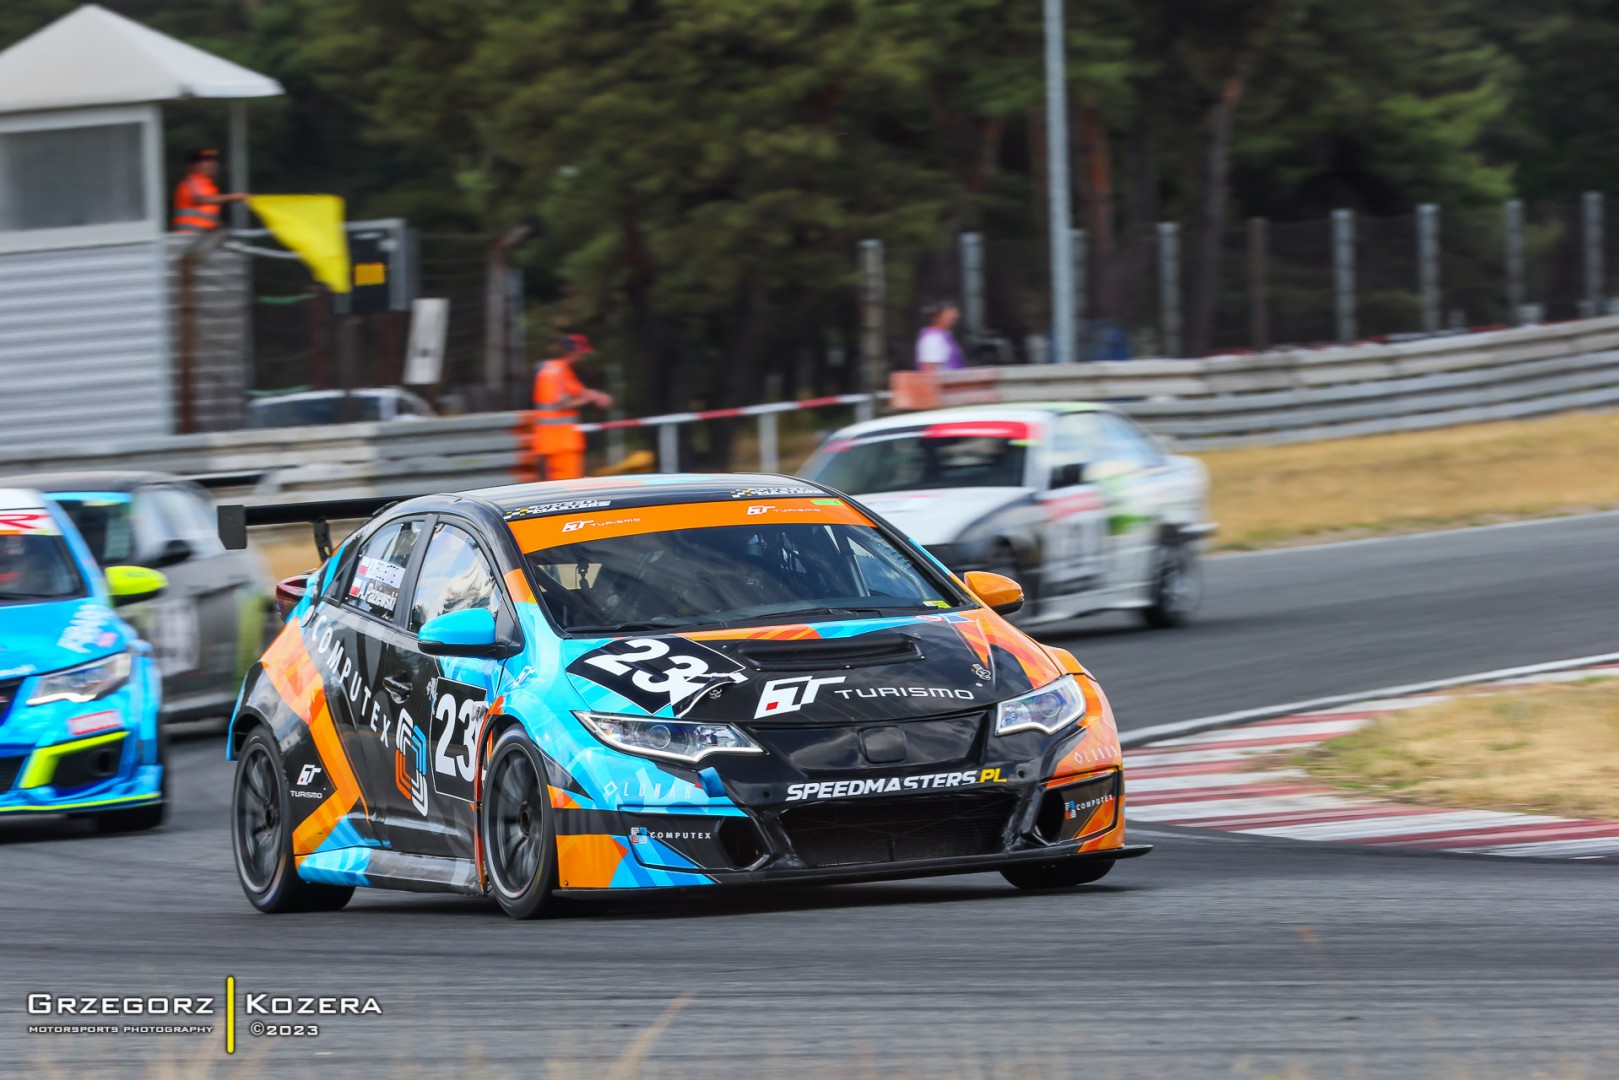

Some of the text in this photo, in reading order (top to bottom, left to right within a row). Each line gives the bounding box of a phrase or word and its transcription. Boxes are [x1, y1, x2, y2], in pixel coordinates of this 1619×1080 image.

[311, 614, 392, 748] COMPUTEX
[834, 687, 975, 700] TURISMO
[785, 768, 1007, 801] SPEEDMASTERS.PL
[290, 790, 322, 798] TURISMO
[1075, 794, 1114, 811] COMPUTEX
[650, 831, 711, 839] COMPUTEX
